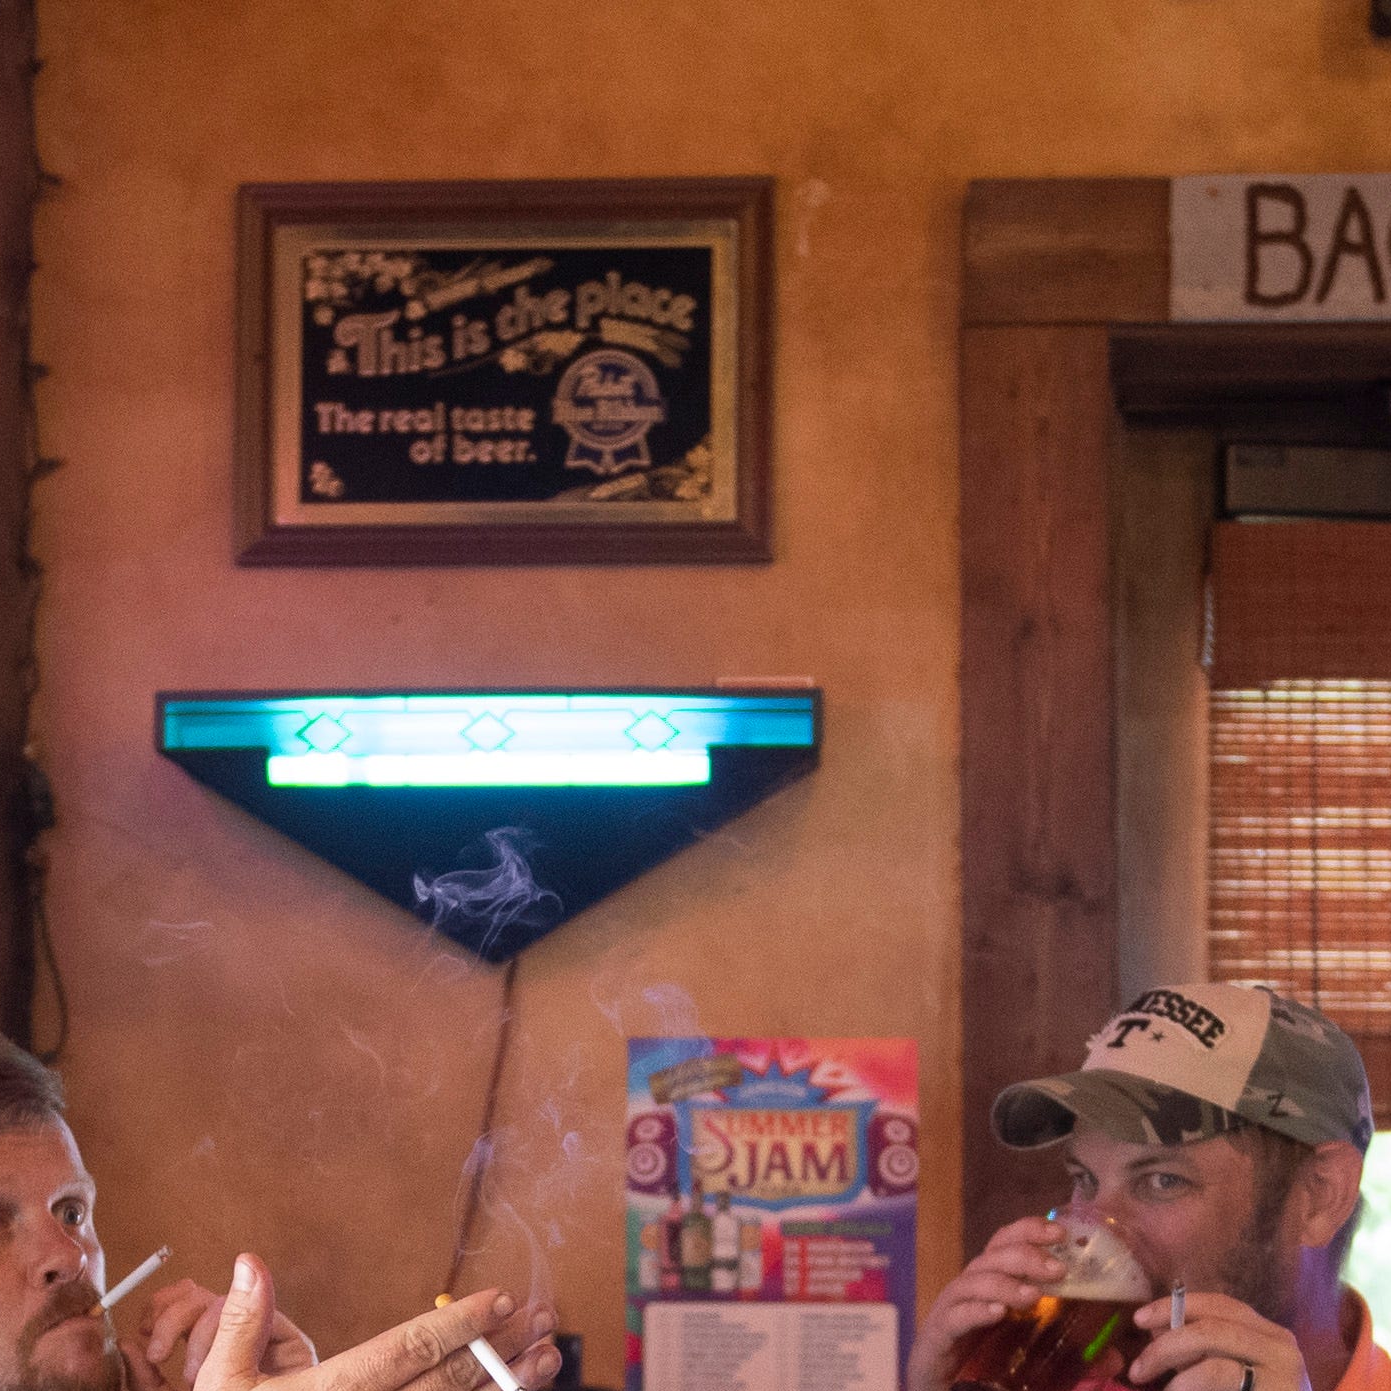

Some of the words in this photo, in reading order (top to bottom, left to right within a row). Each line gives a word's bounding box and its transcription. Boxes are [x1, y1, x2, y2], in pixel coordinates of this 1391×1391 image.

[333, 308, 446, 377] This
[453, 315, 490, 359] is
[495, 285, 571, 341] the
[575, 270, 697, 331] place
[315, 401, 375, 433] The
[378, 401, 446, 433] real
[450, 405, 536, 432] taste
[409, 433, 446, 464] of
[452, 434, 537, 464] beer.
[1107, 1018, 1150, 1047] T
[727, 1141, 850, 1190] JAM
